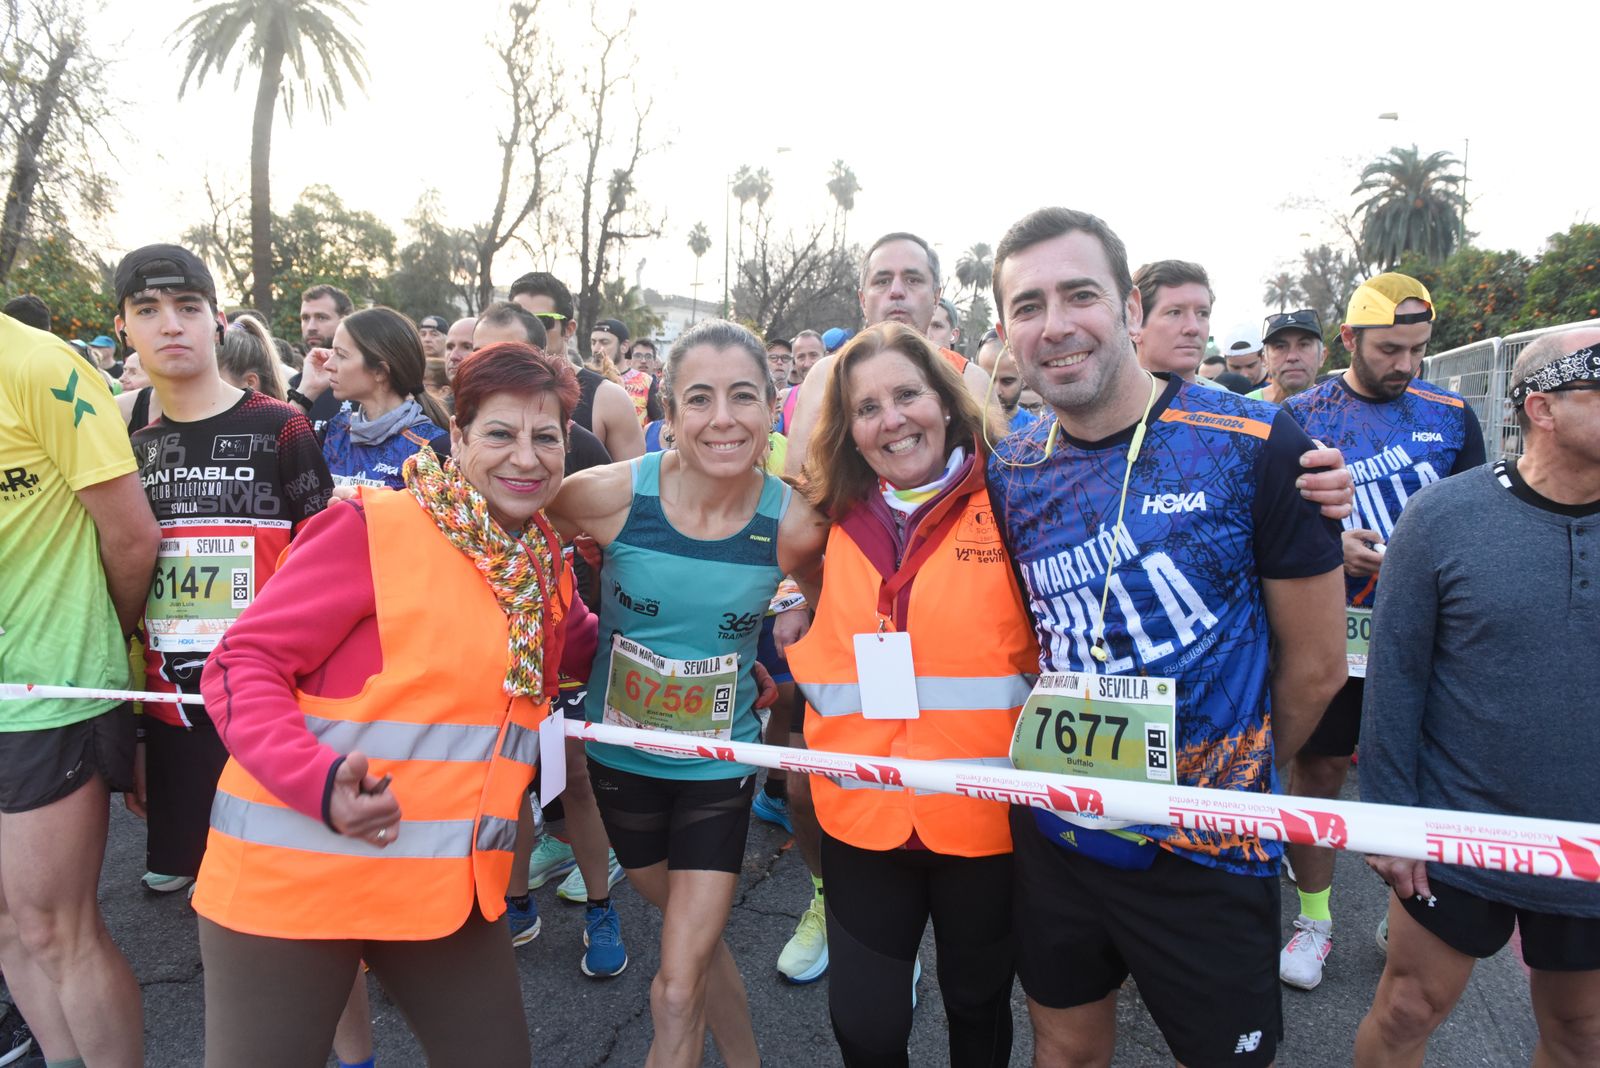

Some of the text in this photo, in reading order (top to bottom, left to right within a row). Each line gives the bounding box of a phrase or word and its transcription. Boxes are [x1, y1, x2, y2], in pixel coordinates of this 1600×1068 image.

[1412, 431, 1443, 443] HOKA
[173, 466, 255, 482] PABLO
[1346, 444, 1413, 485] ARATÓN
[151, 484, 171, 501] CLUB
[1141, 491, 1207, 515] HOKA
[171, 501, 198, 515] SEVILLA
[196, 538, 235, 554] SEVILLA
[1032, 521, 1140, 597] MARATÓN
[153, 565, 221, 600] 6147
[718, 611, 761, 632] 365
[620, 638, 639, 656] MEDIO
[683, 657, 721, 676] SEVILLA
[625, 669, 705, 714] 6756
[1053, 672, 1080, 691] MARATÓN
[1098, 676, 1149, 700] SEVILLA
[1035, 706, 1129, 761] 7677
[1066, 757, 1094, 768] Buffalo
[1168, 795, 1276, 815] Acción Creativa de Eventos
[1424, 821, 1554, 843] Acción Creativa de Eventos
